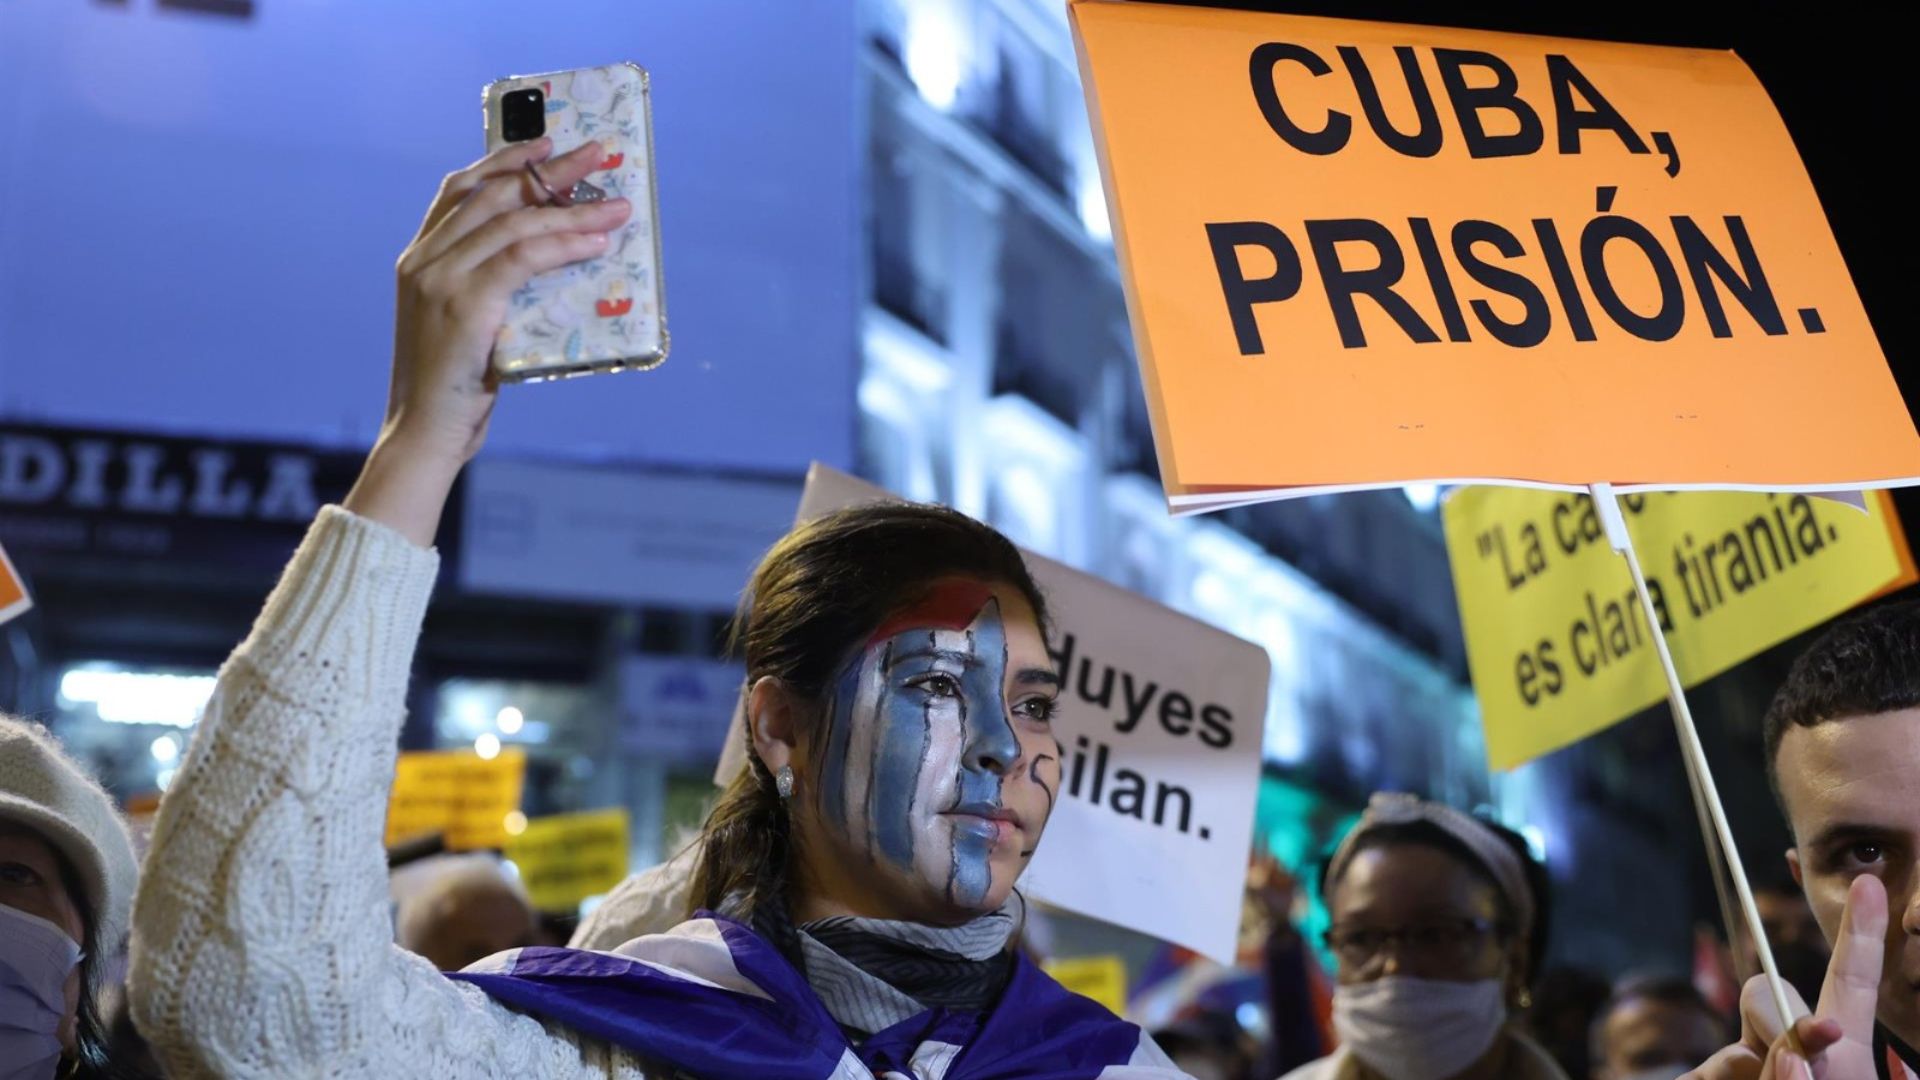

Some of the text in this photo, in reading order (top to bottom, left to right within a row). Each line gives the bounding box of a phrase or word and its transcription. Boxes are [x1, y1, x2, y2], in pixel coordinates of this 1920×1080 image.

[1249, 42, 1681, 178] CUBA,
[1205, 187, 1826, 355] PRISIÓN.
[1477, 522, 1548, 591] "La
[1515, 638, 1564, 706] es
[1571, 577, 1674, 676] clara
[1056, 736, 1211, 840] ilan.
